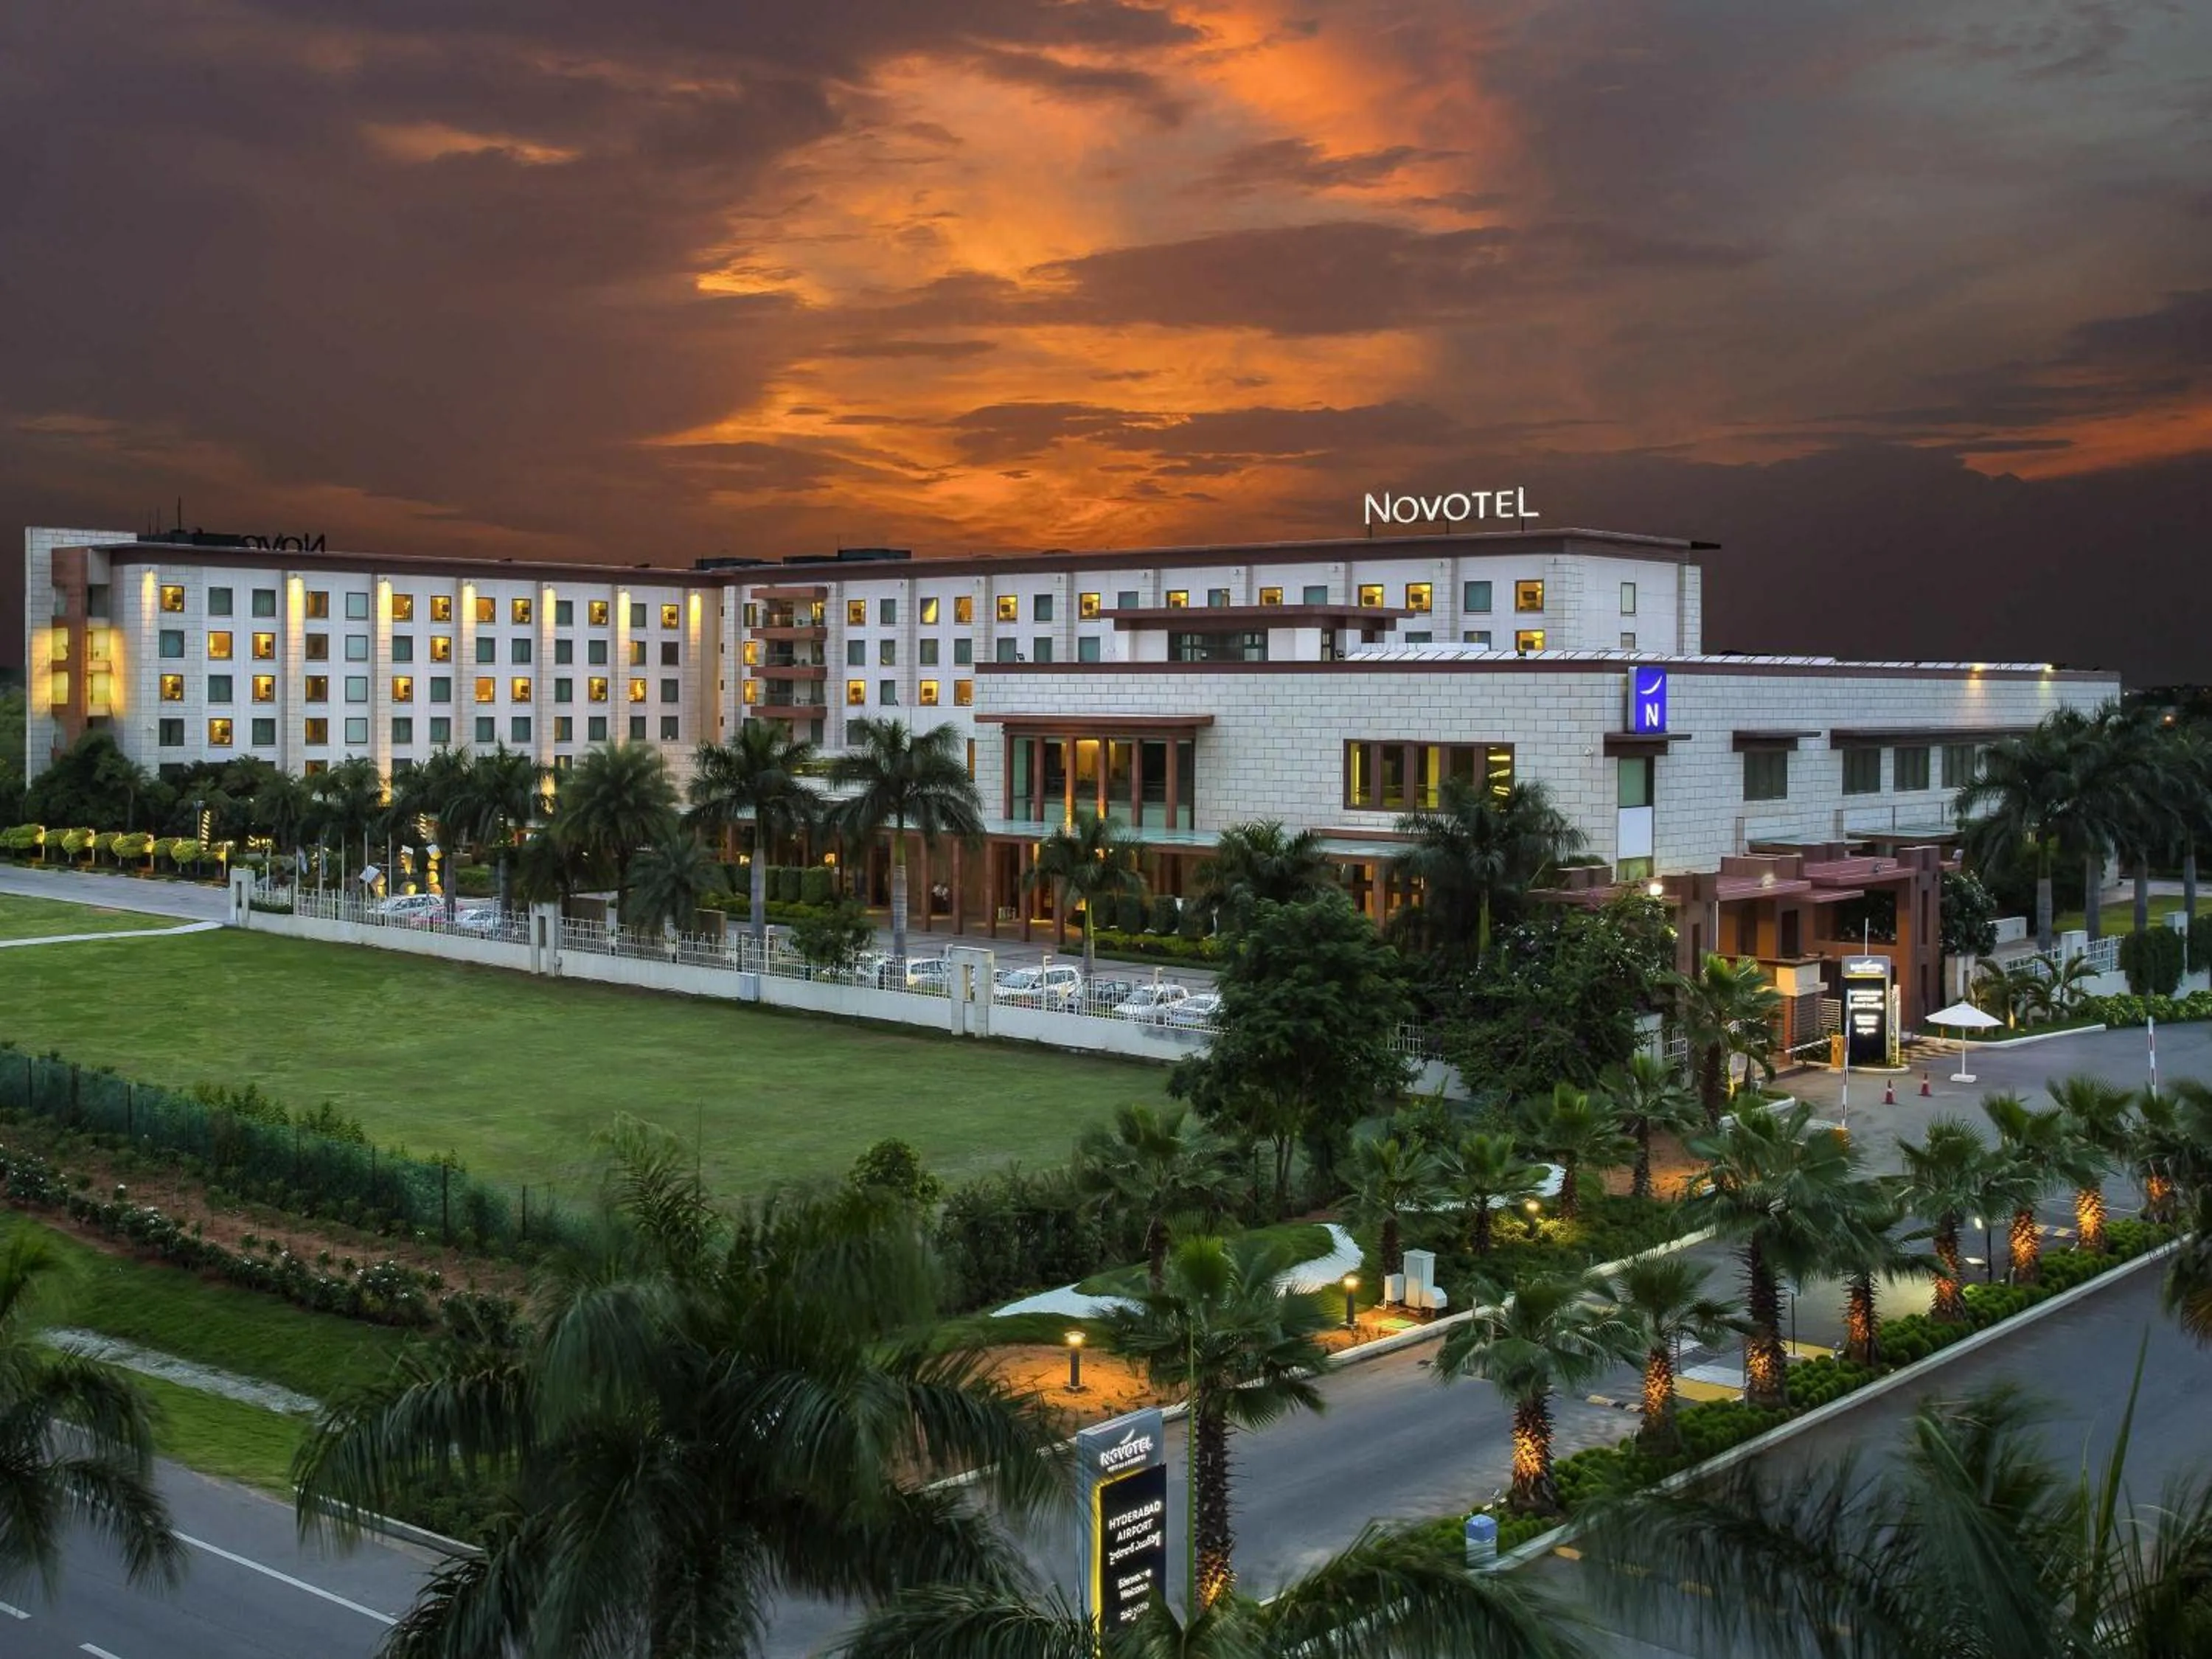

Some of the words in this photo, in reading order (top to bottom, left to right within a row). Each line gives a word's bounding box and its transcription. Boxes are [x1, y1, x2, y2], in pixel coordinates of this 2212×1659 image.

[1364, 486, 1540, 525] NOVOTEL
[1645, 703, 1659, 728] N
[1100, 1436, 1153, 1467] NOVOTEL
[1108, 1500, 1162, 1531] HYDERABAD
[1116, 1518, 1154, 1543] AIRPORT
